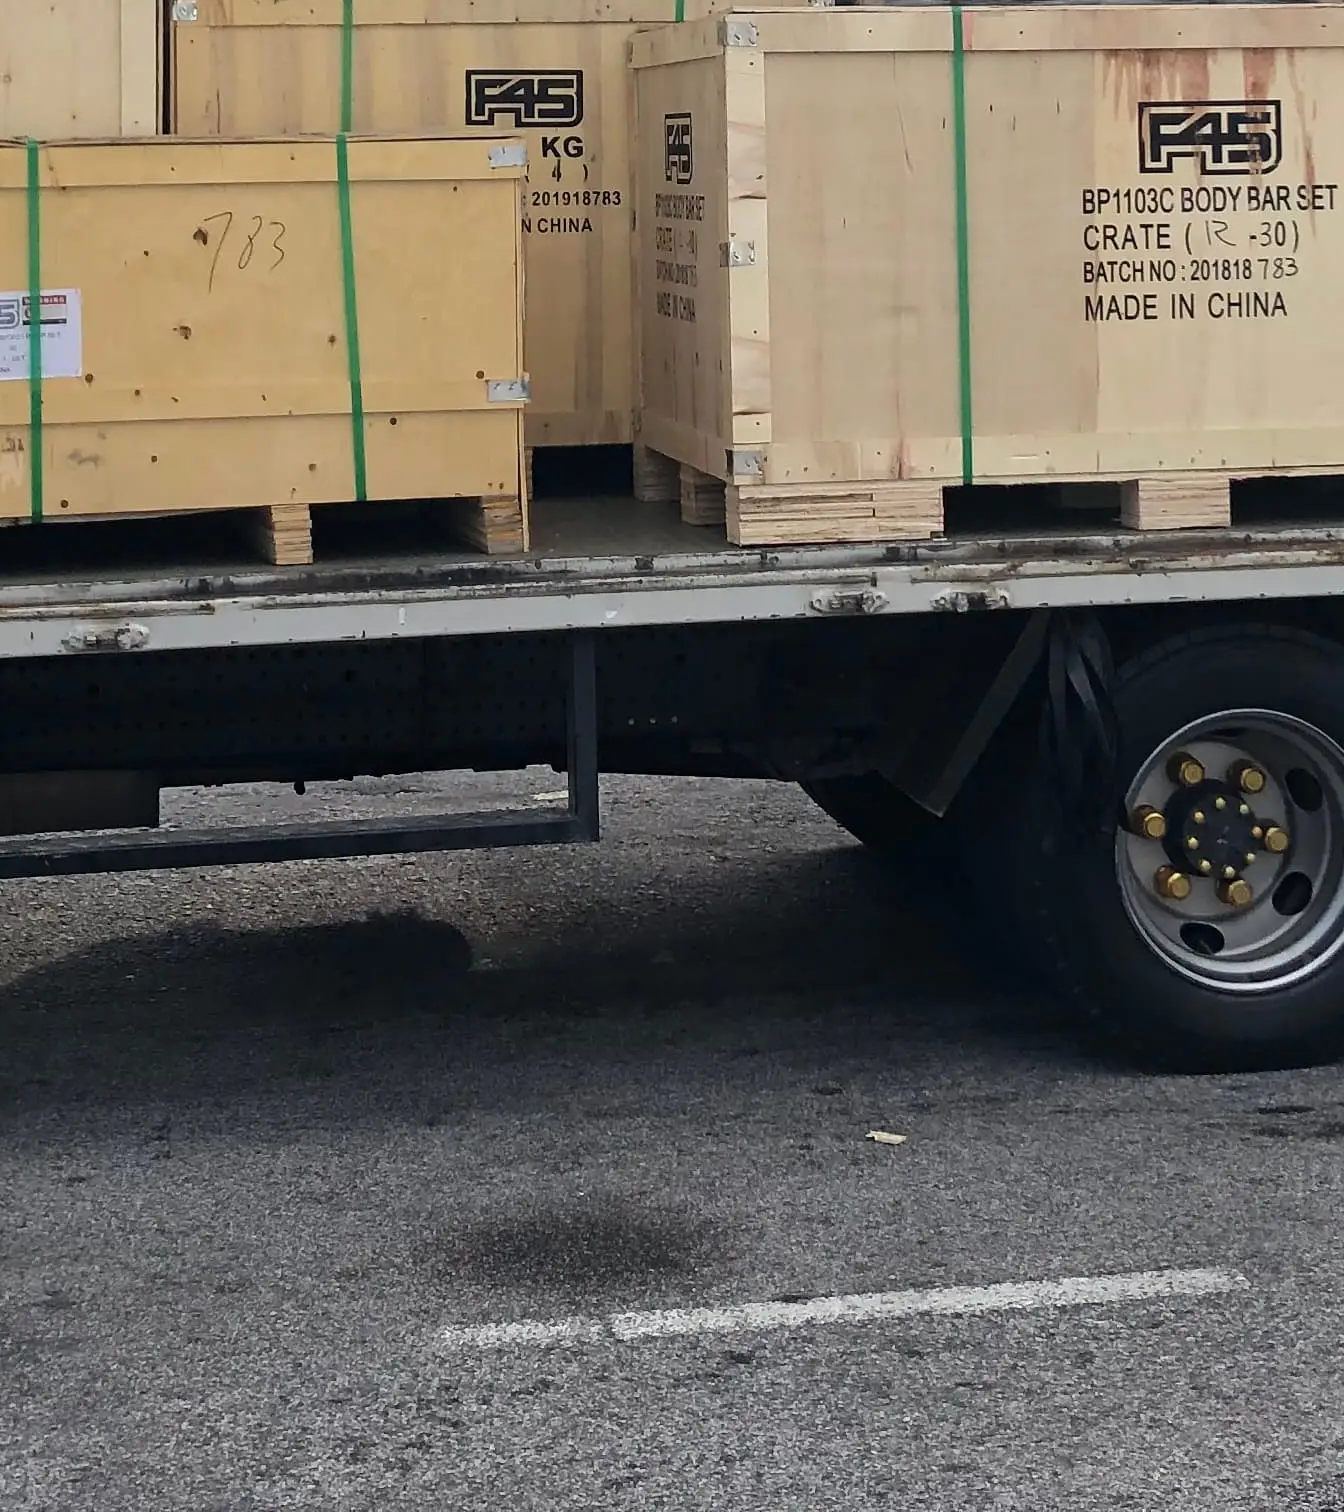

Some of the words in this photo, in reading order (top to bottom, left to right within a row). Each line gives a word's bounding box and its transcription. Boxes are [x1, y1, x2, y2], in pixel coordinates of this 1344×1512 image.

[541, 136, 584, 158] KG
[532, 191, 622, 206] 201918783
[1082, 188, 1174, 214] BP1103C
[1181, 187, 1242, 212] BODY
[1248, 186, 1291, 211] BAR
[1297, 185, 1338, 210] SET
[537, 218, 593, 233] CHINA
[1083, 224, 1171, 250] CRATE
[1083, 260, 1145, 283] BATCH
[1085, 294, 1158, 321] MADE
[1171, 293, 1195, 319] IN
[1208, 291, 1288, 319] CHINA
